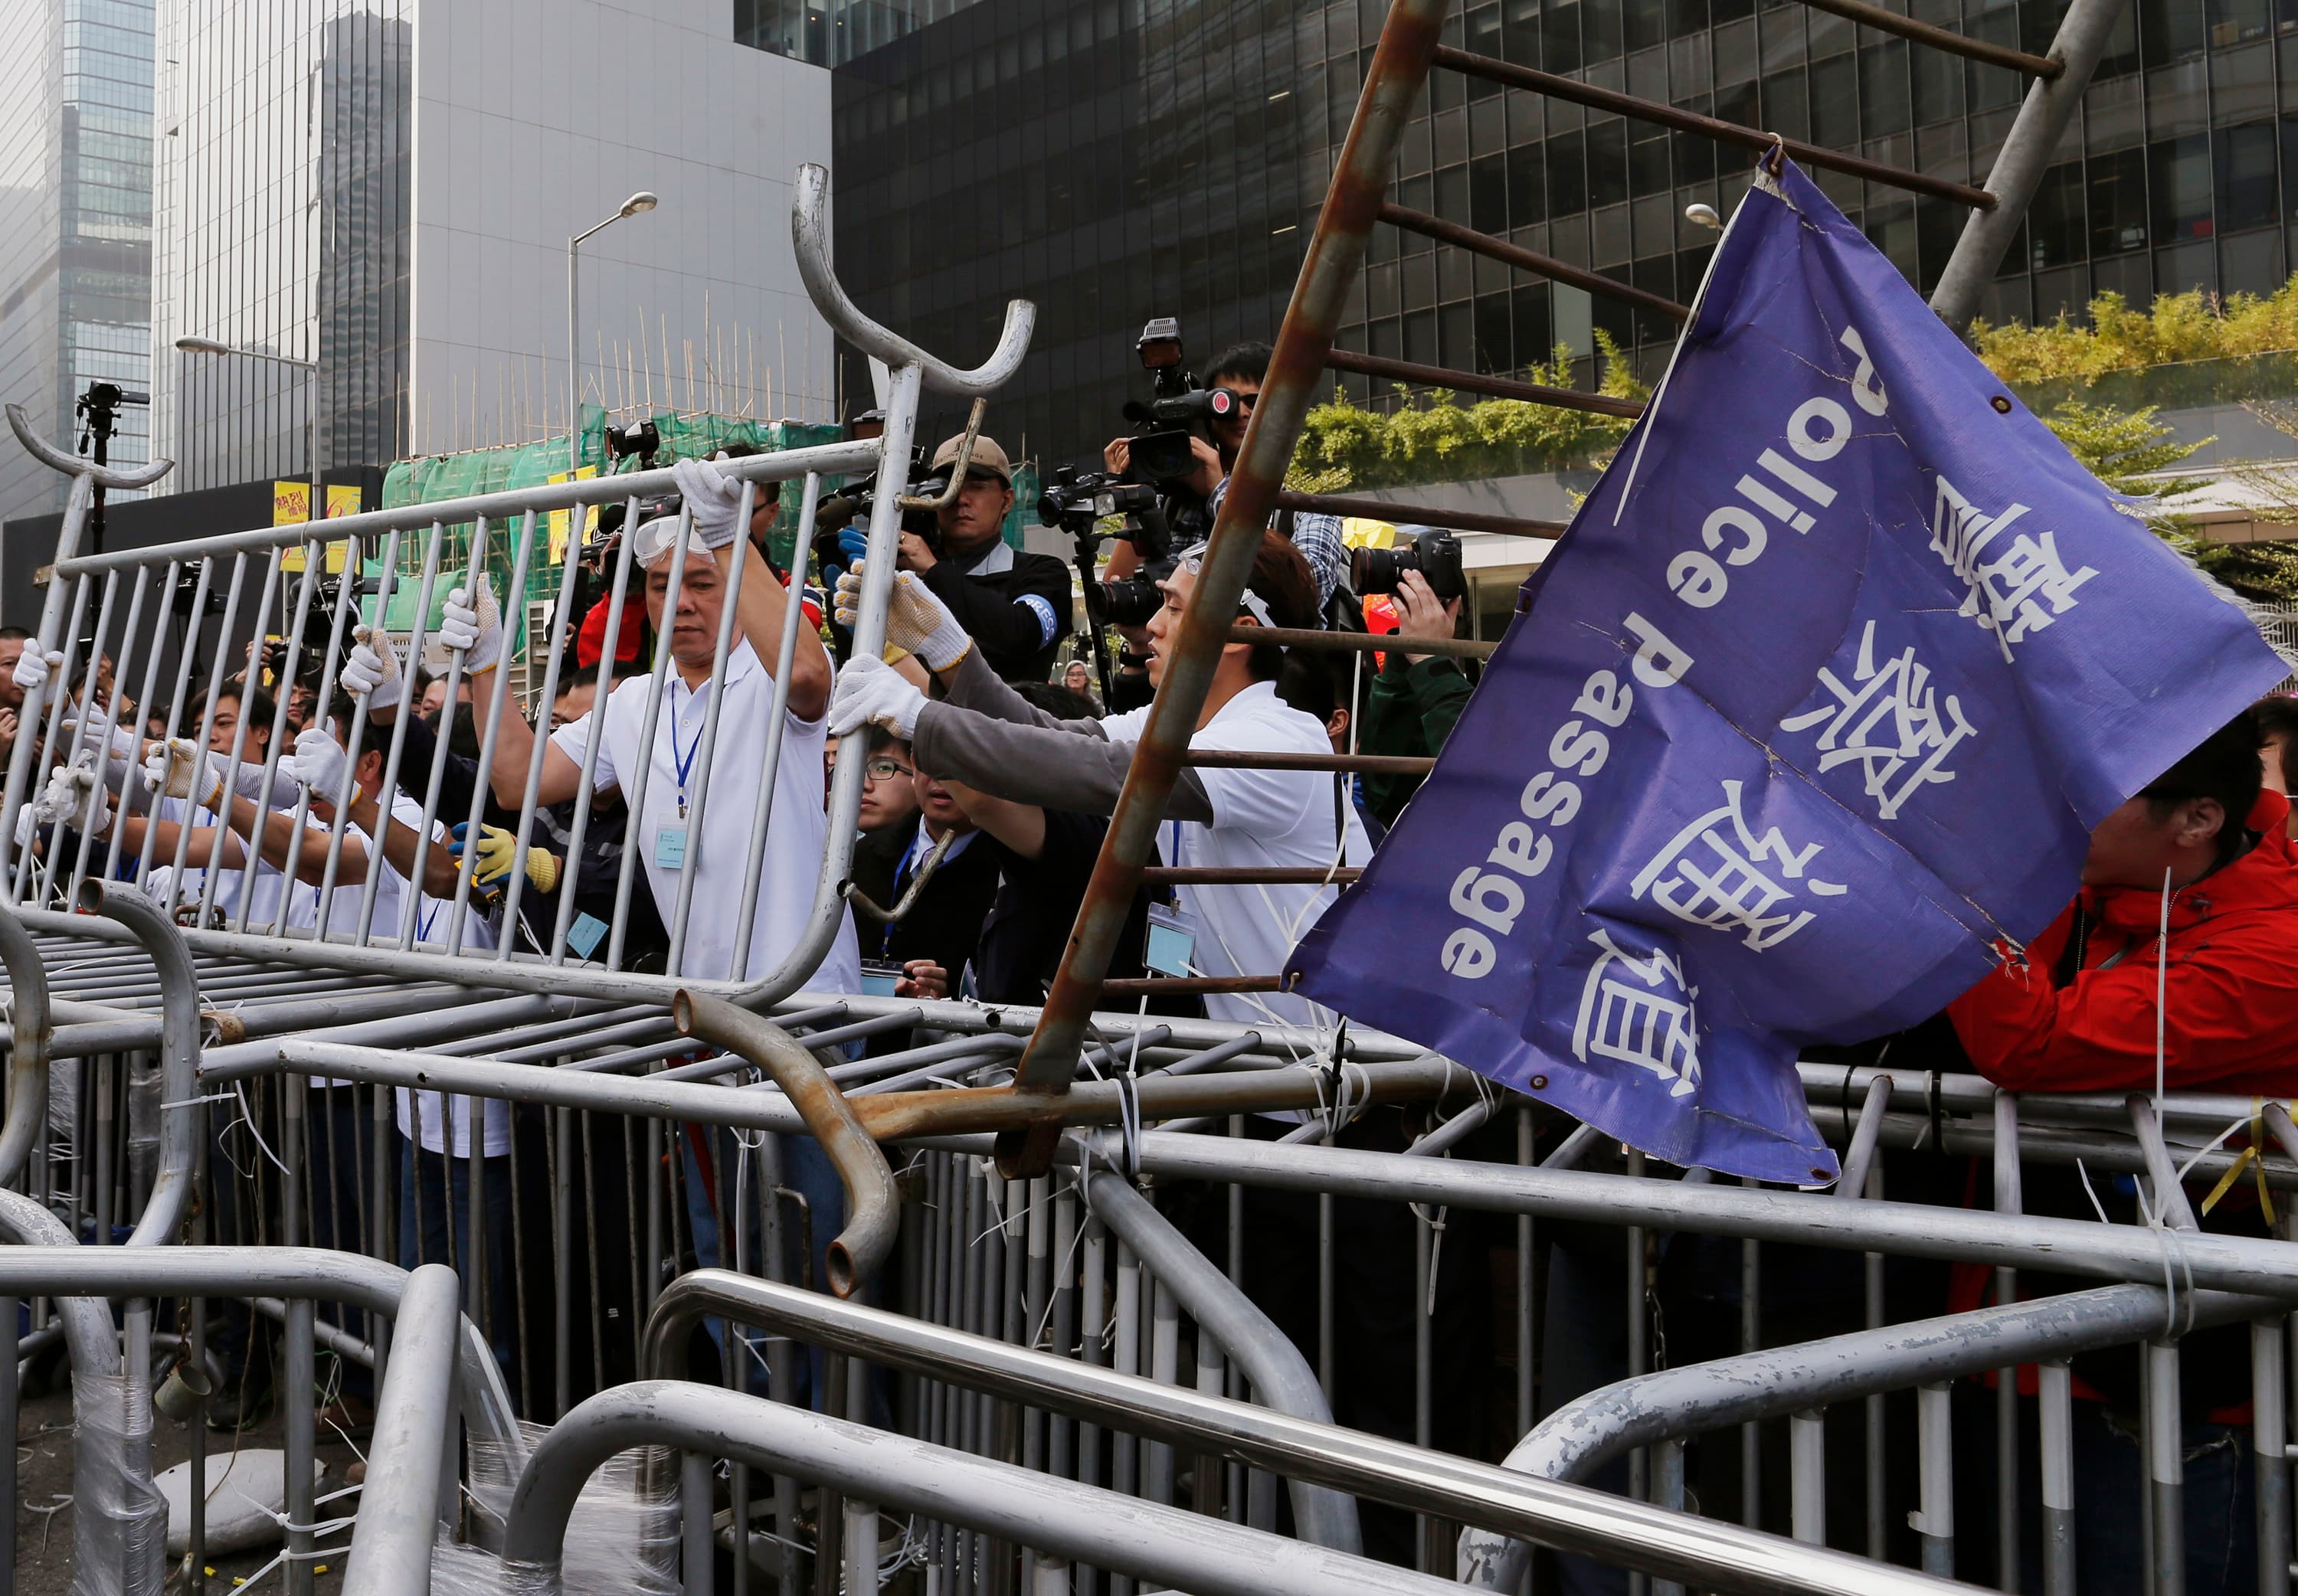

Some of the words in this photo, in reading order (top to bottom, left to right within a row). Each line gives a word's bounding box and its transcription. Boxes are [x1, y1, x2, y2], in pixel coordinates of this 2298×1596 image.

[1025, 598, 1055, 641] PRESS
[1666, 325, 1889, 609] Police
[1440, 610, 1695, 980] Passage
[1572, 474, 2100, 1098] 警察通道
